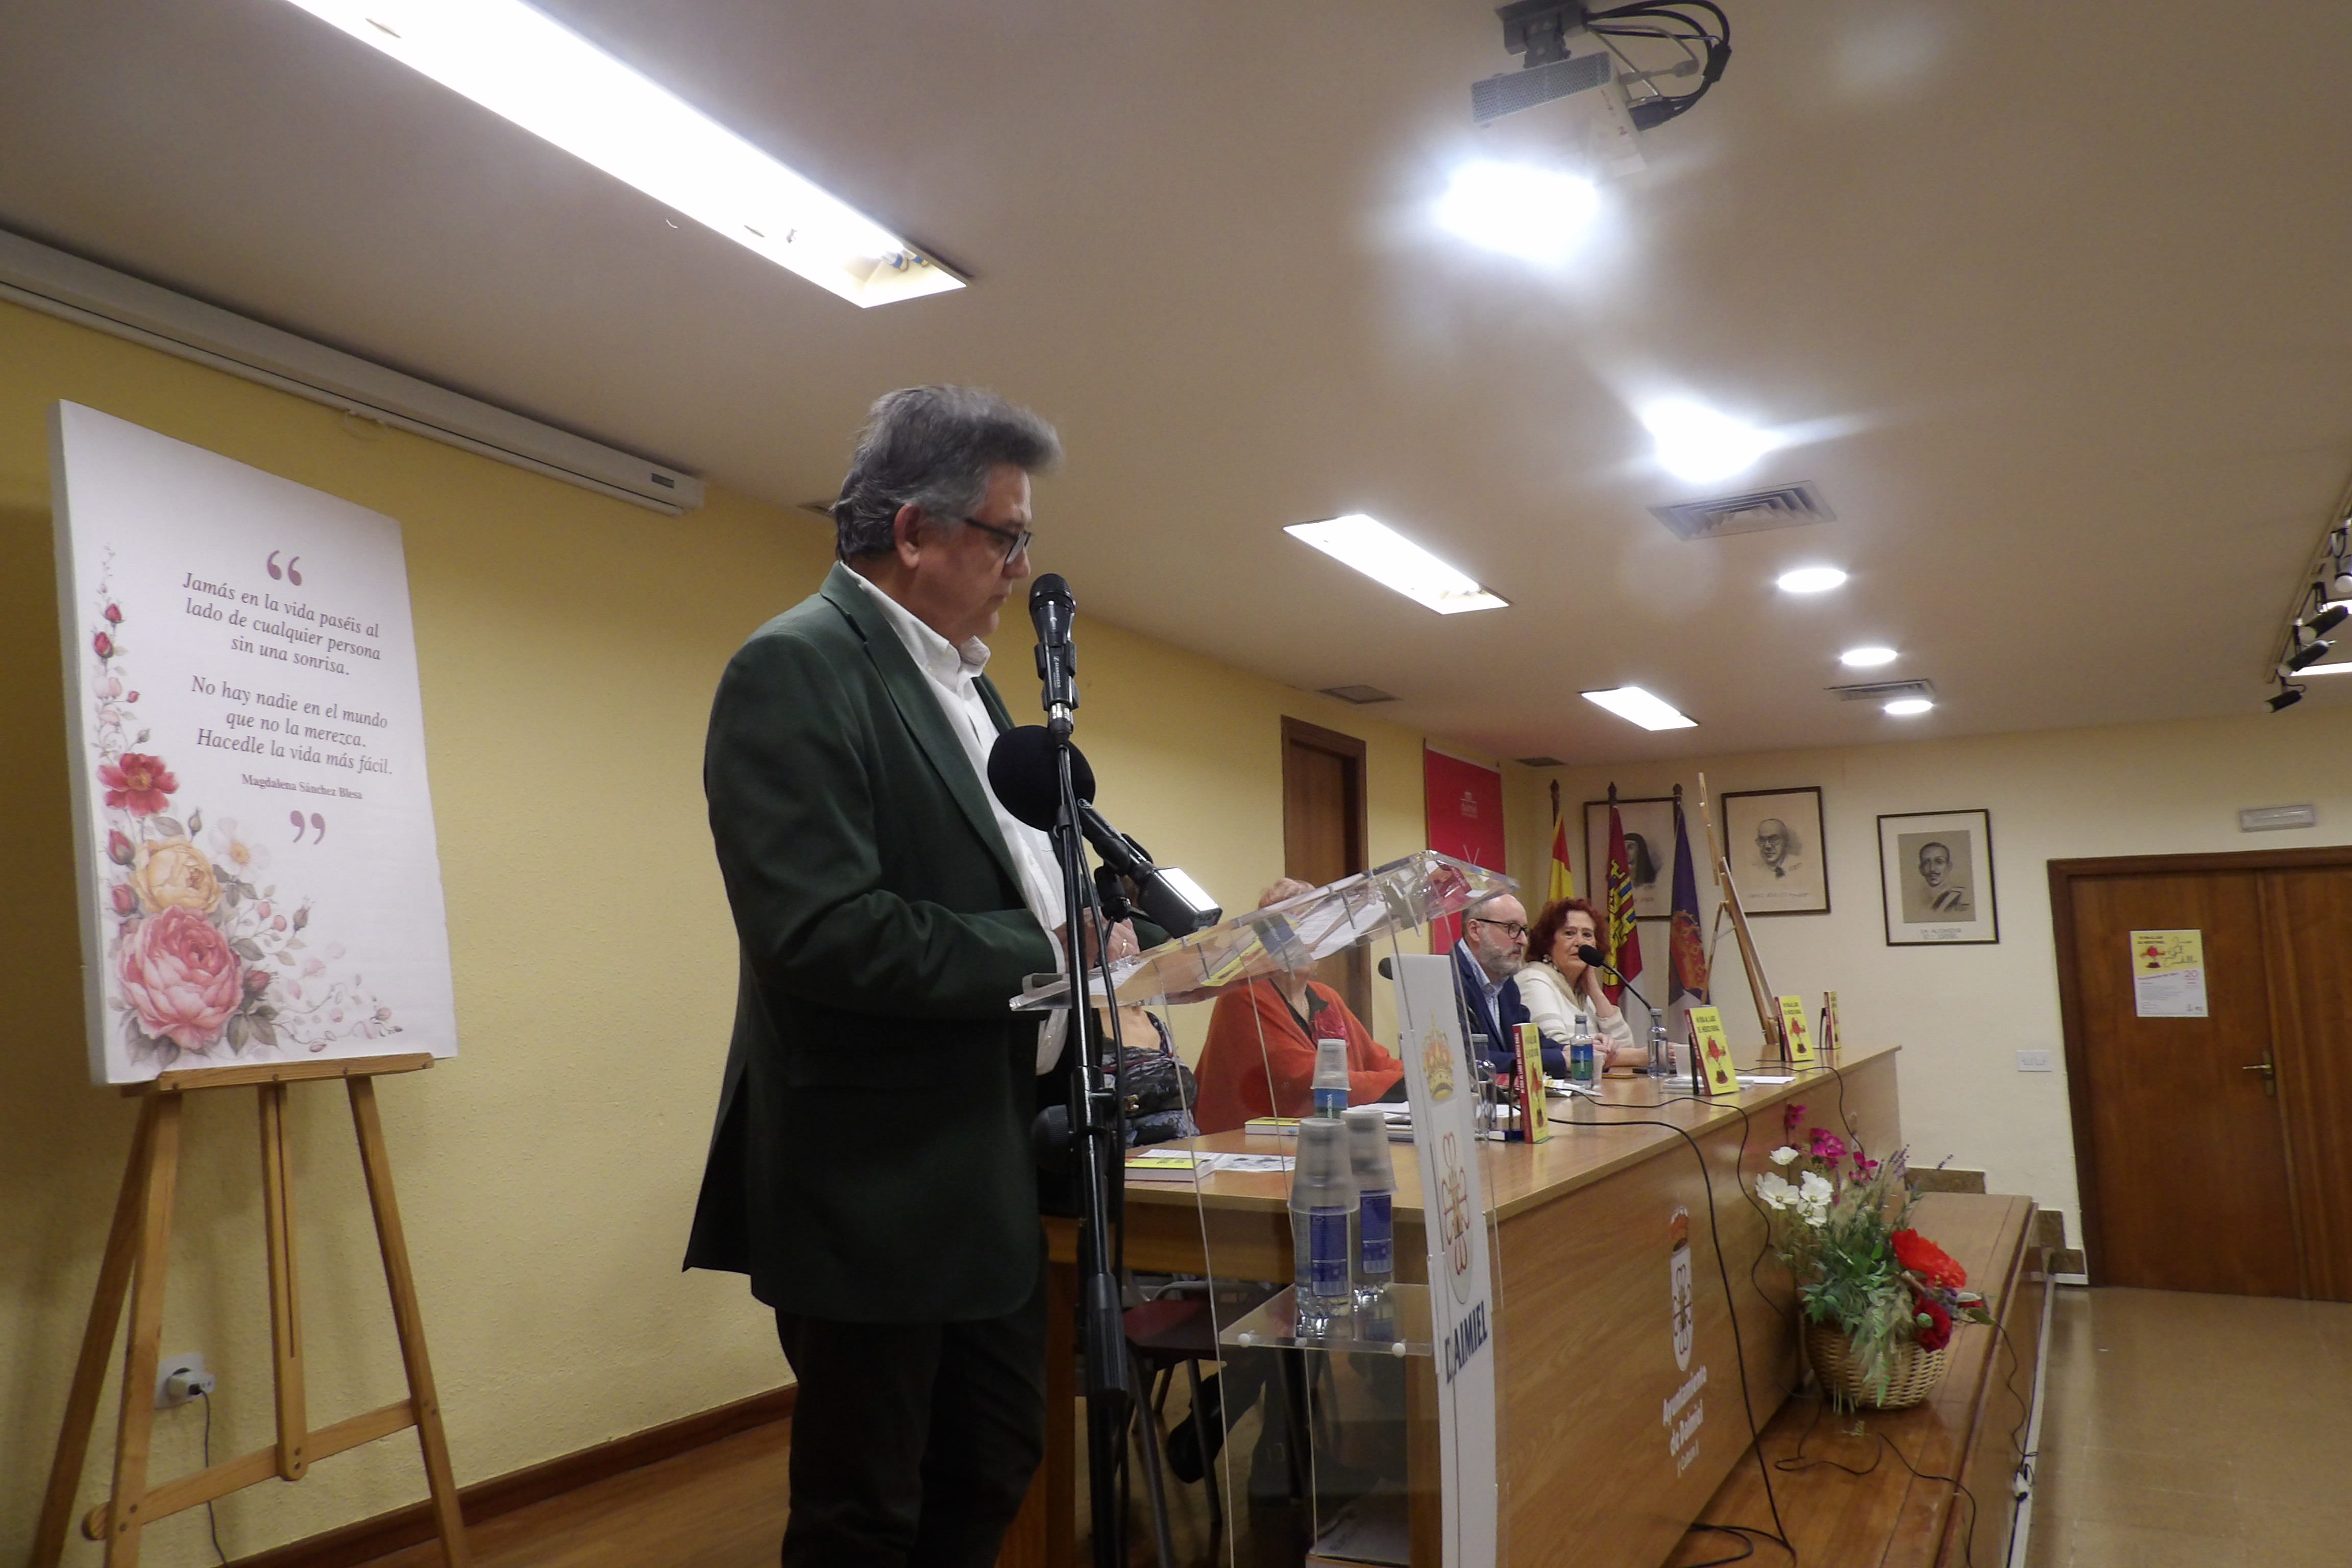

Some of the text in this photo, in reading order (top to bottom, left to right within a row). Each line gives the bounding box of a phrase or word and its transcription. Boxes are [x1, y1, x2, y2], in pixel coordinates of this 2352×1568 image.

[183, 573, 378, 638] Jamás en la vida paséis al
[186, 598, 380, 659] lado de cualquier persona
[231, 636, 350, 675] sin una sonrisa.
[191, 675, 387, 728] No hay nadie en el mundo
[197, 728, 392, 774] Hacedle la vida más fácil.
[226, 713, 366, 747] que no la merezca.
[241, 774, 362, 799] Magdalena Sánchez Blesa
